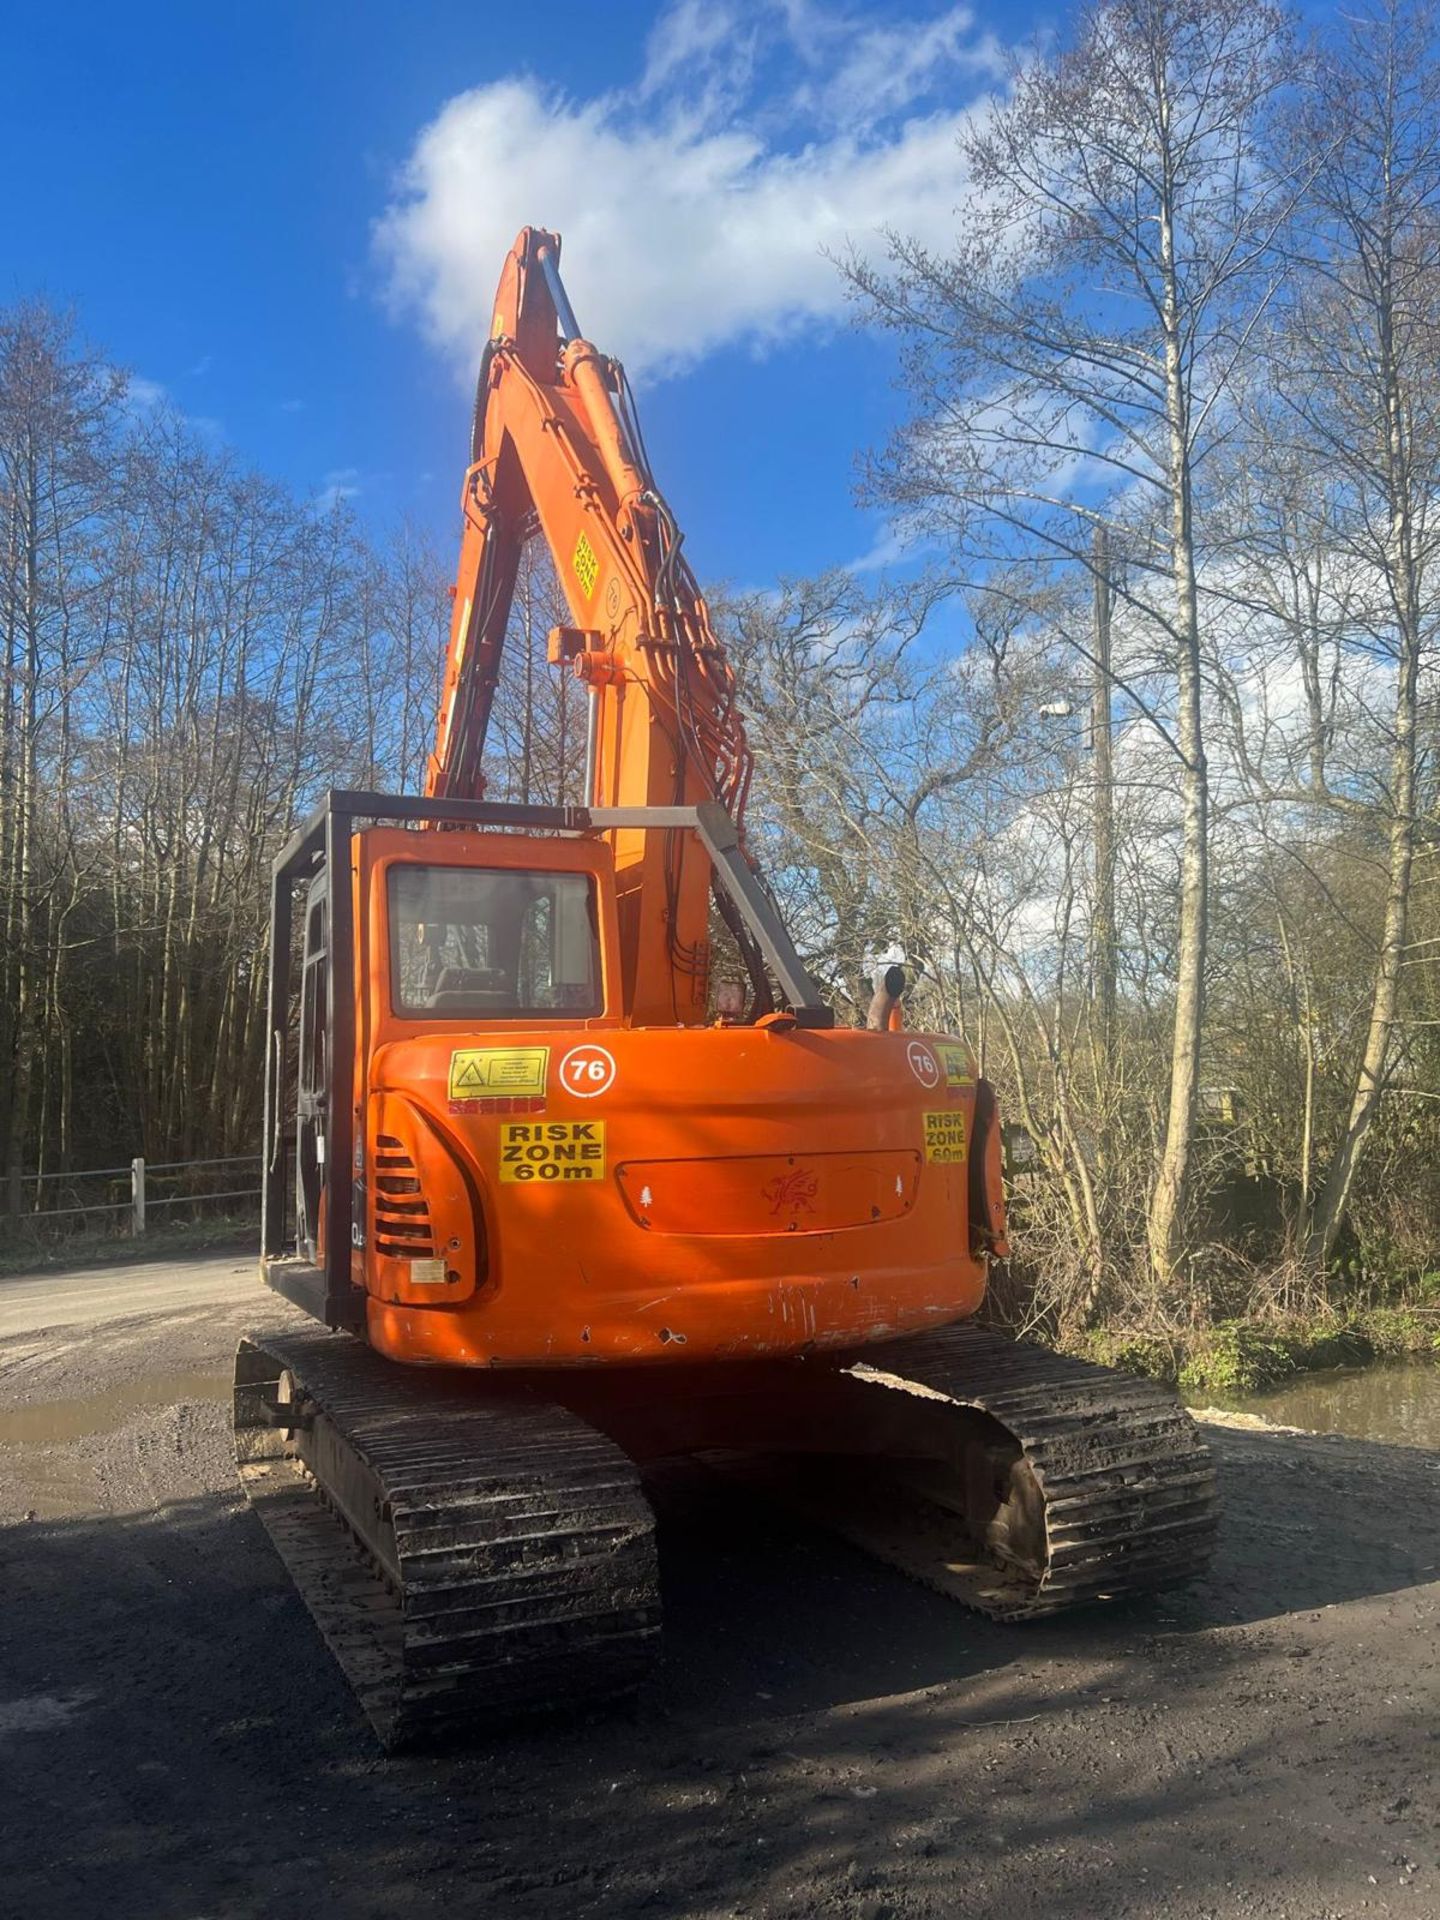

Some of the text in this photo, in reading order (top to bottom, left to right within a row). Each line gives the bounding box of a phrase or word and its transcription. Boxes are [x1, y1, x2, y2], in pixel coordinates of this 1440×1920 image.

[571, 1060, 605, 1080] 76
[913, 1056, 933, 1073] 76
[927, 1114, 961, 1129] RISK
[509, 1124, 595, 1142] RISK
[927, 1130, 965, 1146] ZONE
[503, 1144, 602, 1162] ZONE
[933, 1148, 963, 1161] 60m
[514, 1164, 593, 1180] 60m
